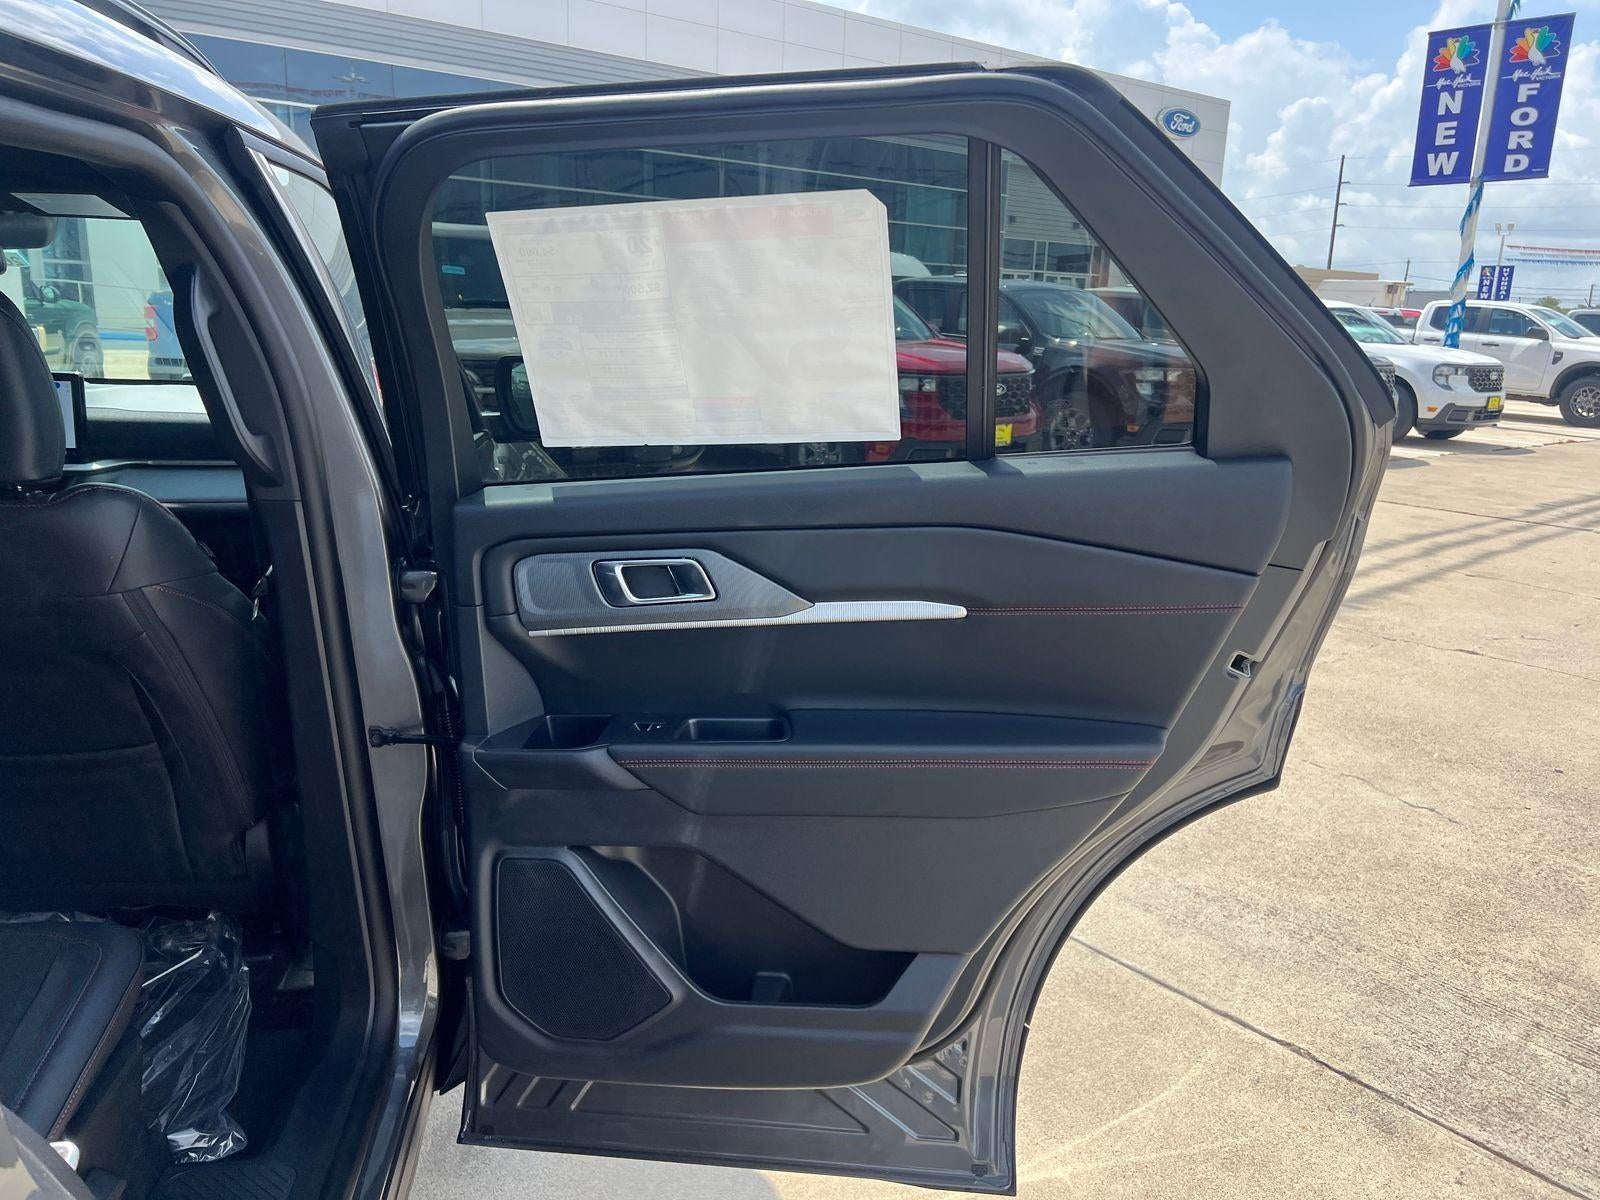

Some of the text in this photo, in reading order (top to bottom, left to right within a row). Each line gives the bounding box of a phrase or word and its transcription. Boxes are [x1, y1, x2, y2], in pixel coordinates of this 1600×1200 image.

[1170, 113, 1196, 133] Ford
[1427, 90, 1463, 176] NEW
[1503, 83, 1540, 173] FORD
[1480, 279, 1490, 299] NEW
[1499, 267, 1510, 299] HYUNDAI
